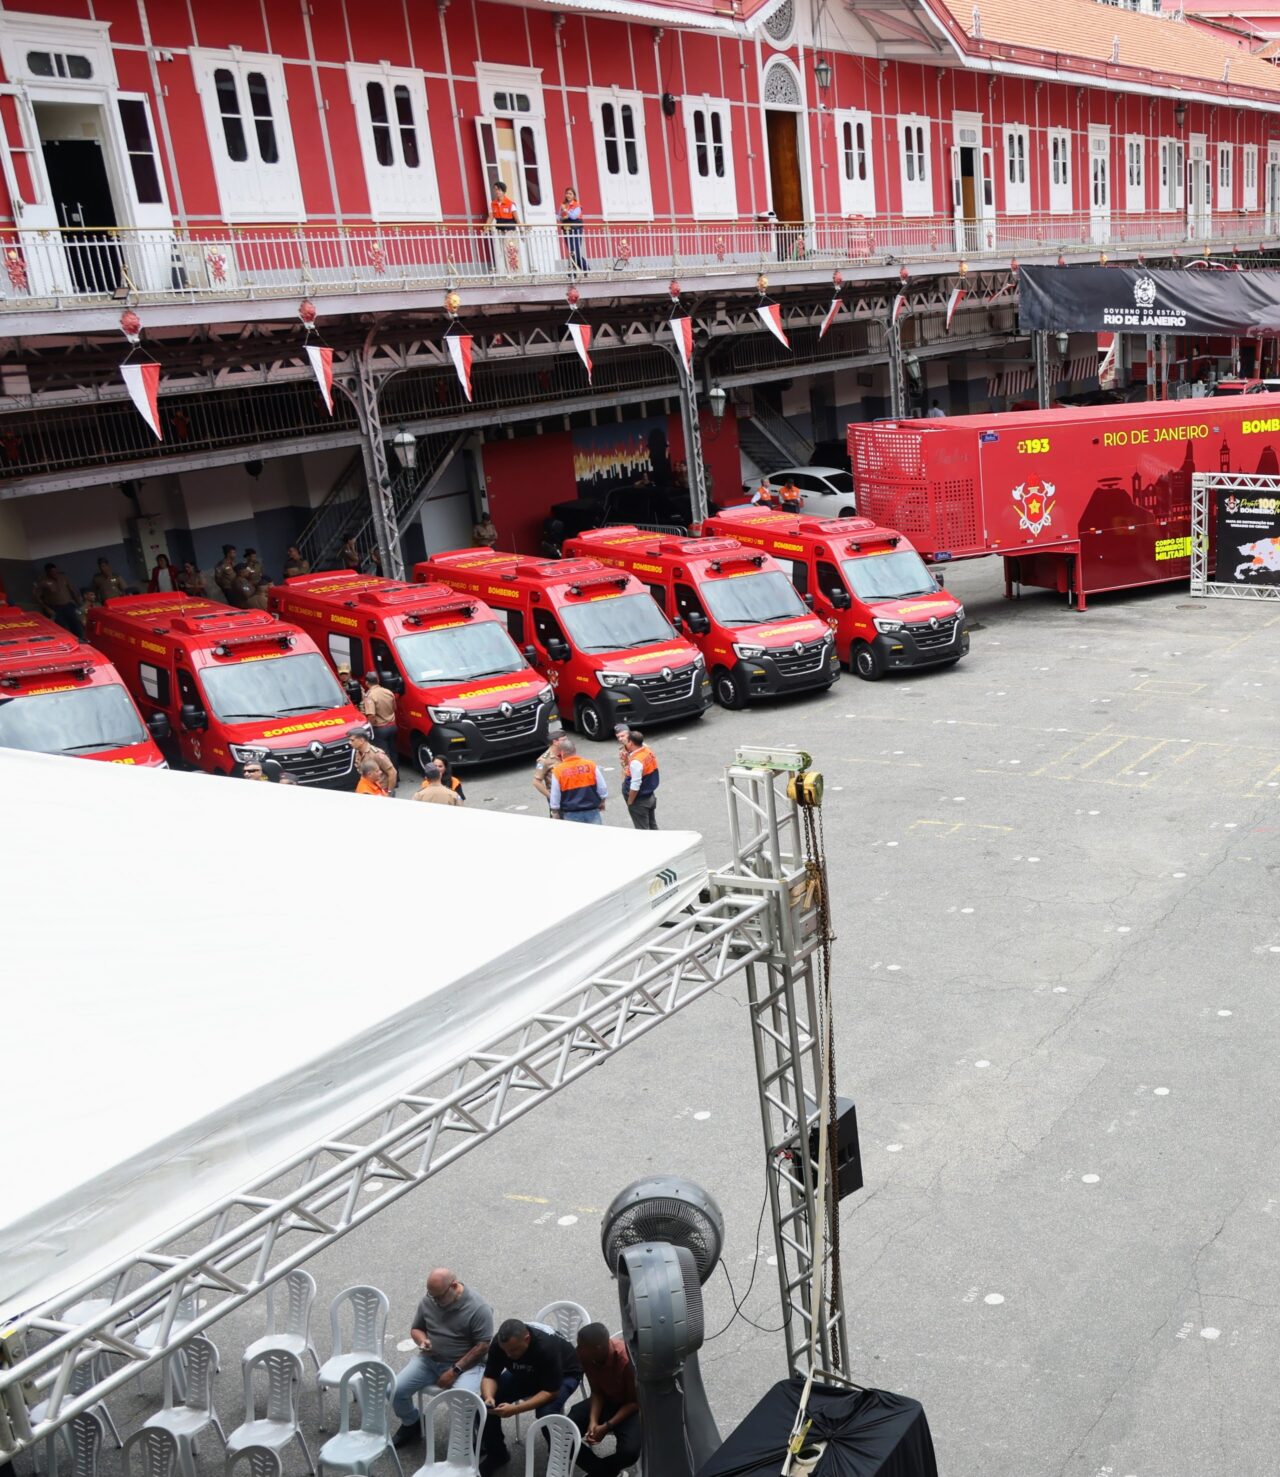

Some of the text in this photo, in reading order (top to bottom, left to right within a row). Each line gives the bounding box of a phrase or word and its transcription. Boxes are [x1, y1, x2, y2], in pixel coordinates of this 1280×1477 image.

[1104, 314, 1186, 327] RIO DE JANEIRO
[1104, 424, 1209, 446] RIO DE JANEIRO
[1026, 439, 1050, 454] 193
[773, 541, 803, 553] BOMBEIROS
[1155, 538, 1175, 547] CORPO
[1155, 550, 1184, 561] MILITAR
[633, 562, 662, 574] BOMBEIROS
[487, 586, 520, 598] BOMBEIROS
[330, 614, 358, 628] BOMBEIROS
[28, 683, 77, 696] AMBULÂNCIA
